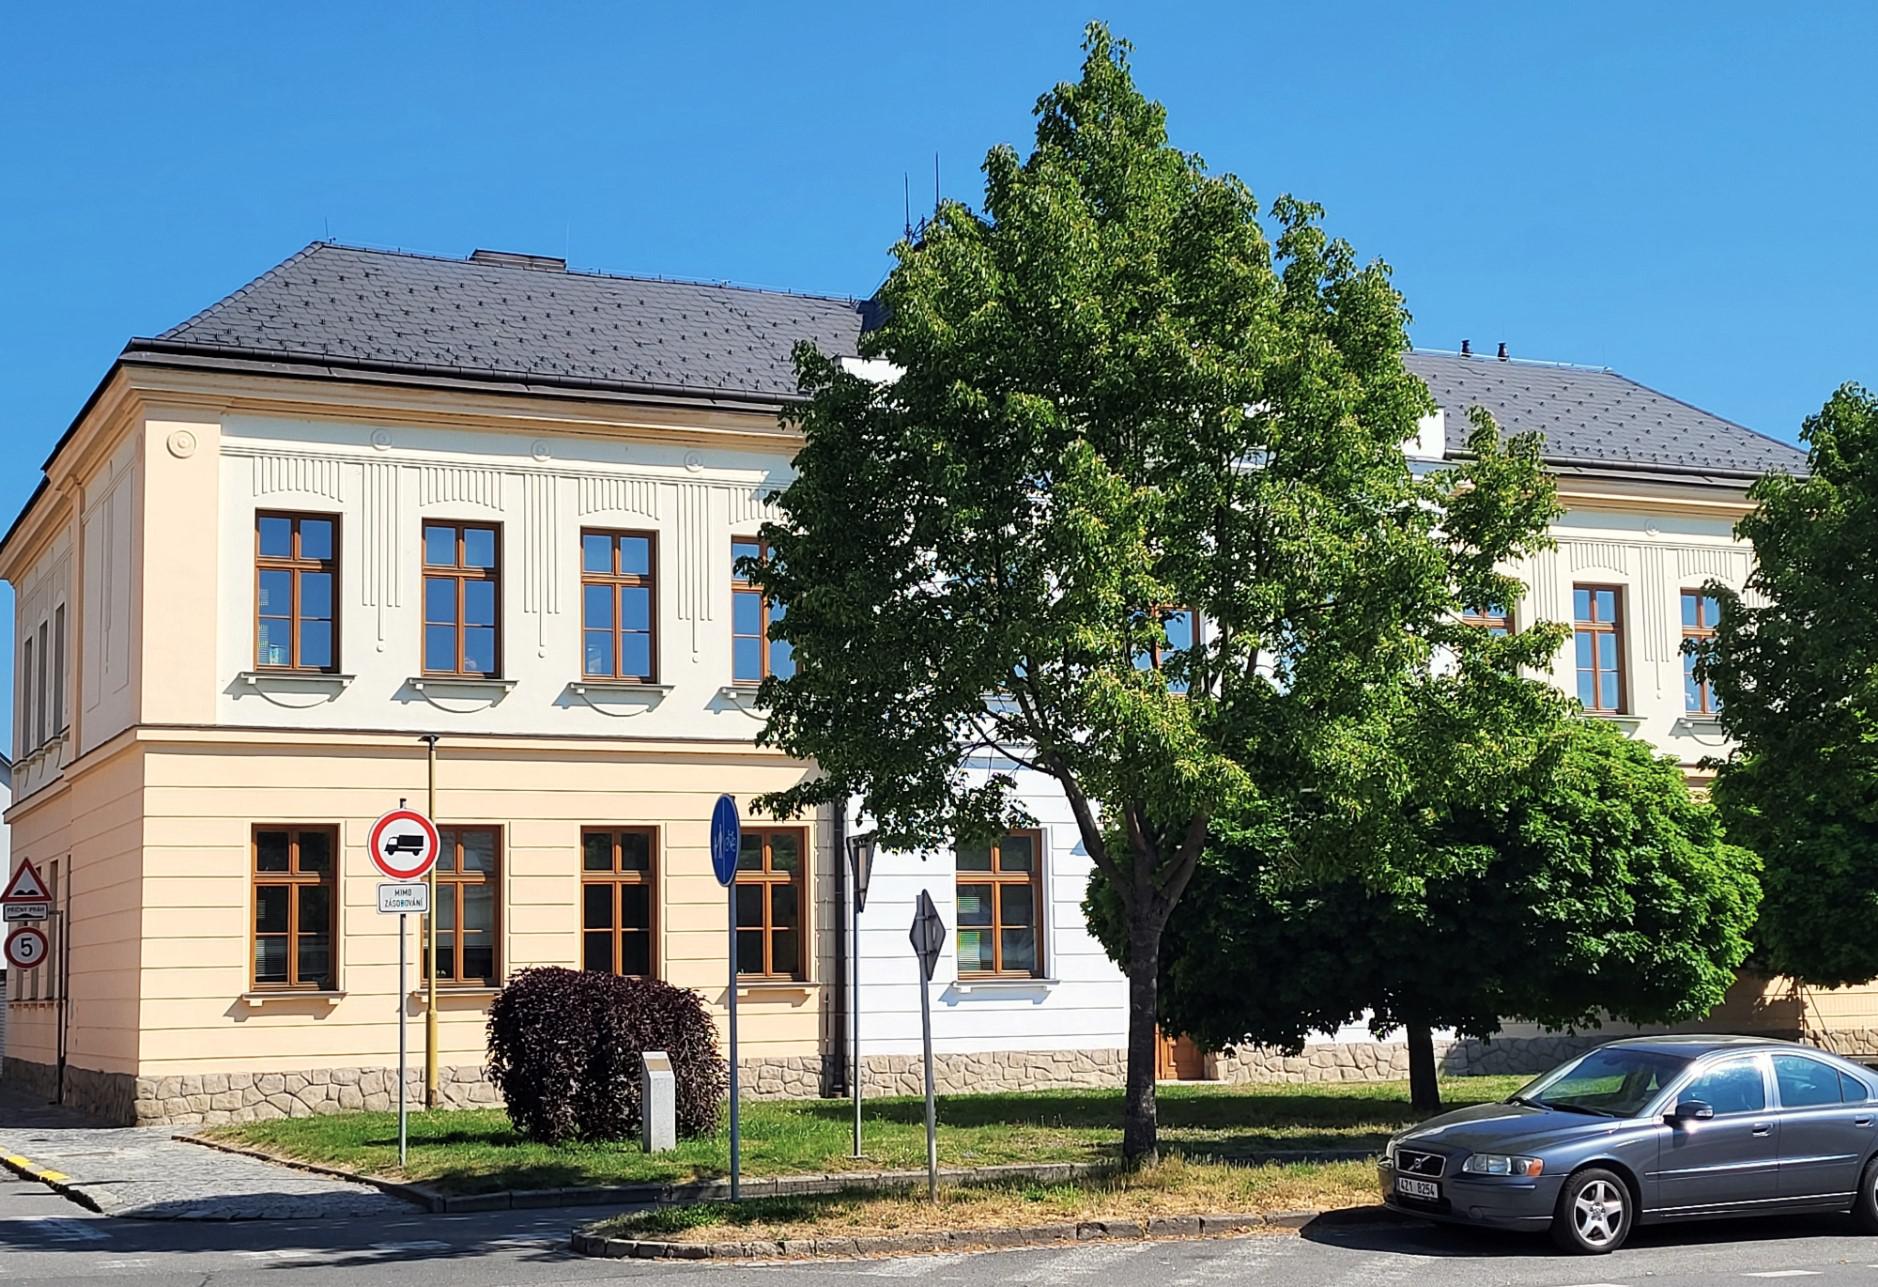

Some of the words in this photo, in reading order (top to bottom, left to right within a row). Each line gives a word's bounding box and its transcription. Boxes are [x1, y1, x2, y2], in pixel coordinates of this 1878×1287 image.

[384, 898, 423, 908] ZÁSOBOVÁNÍ
[21, 937, 33, 957] 5
[1400, 1178, 1413, 1192] 4Z1
[1417, 1182, 1435, 1195] 8254
